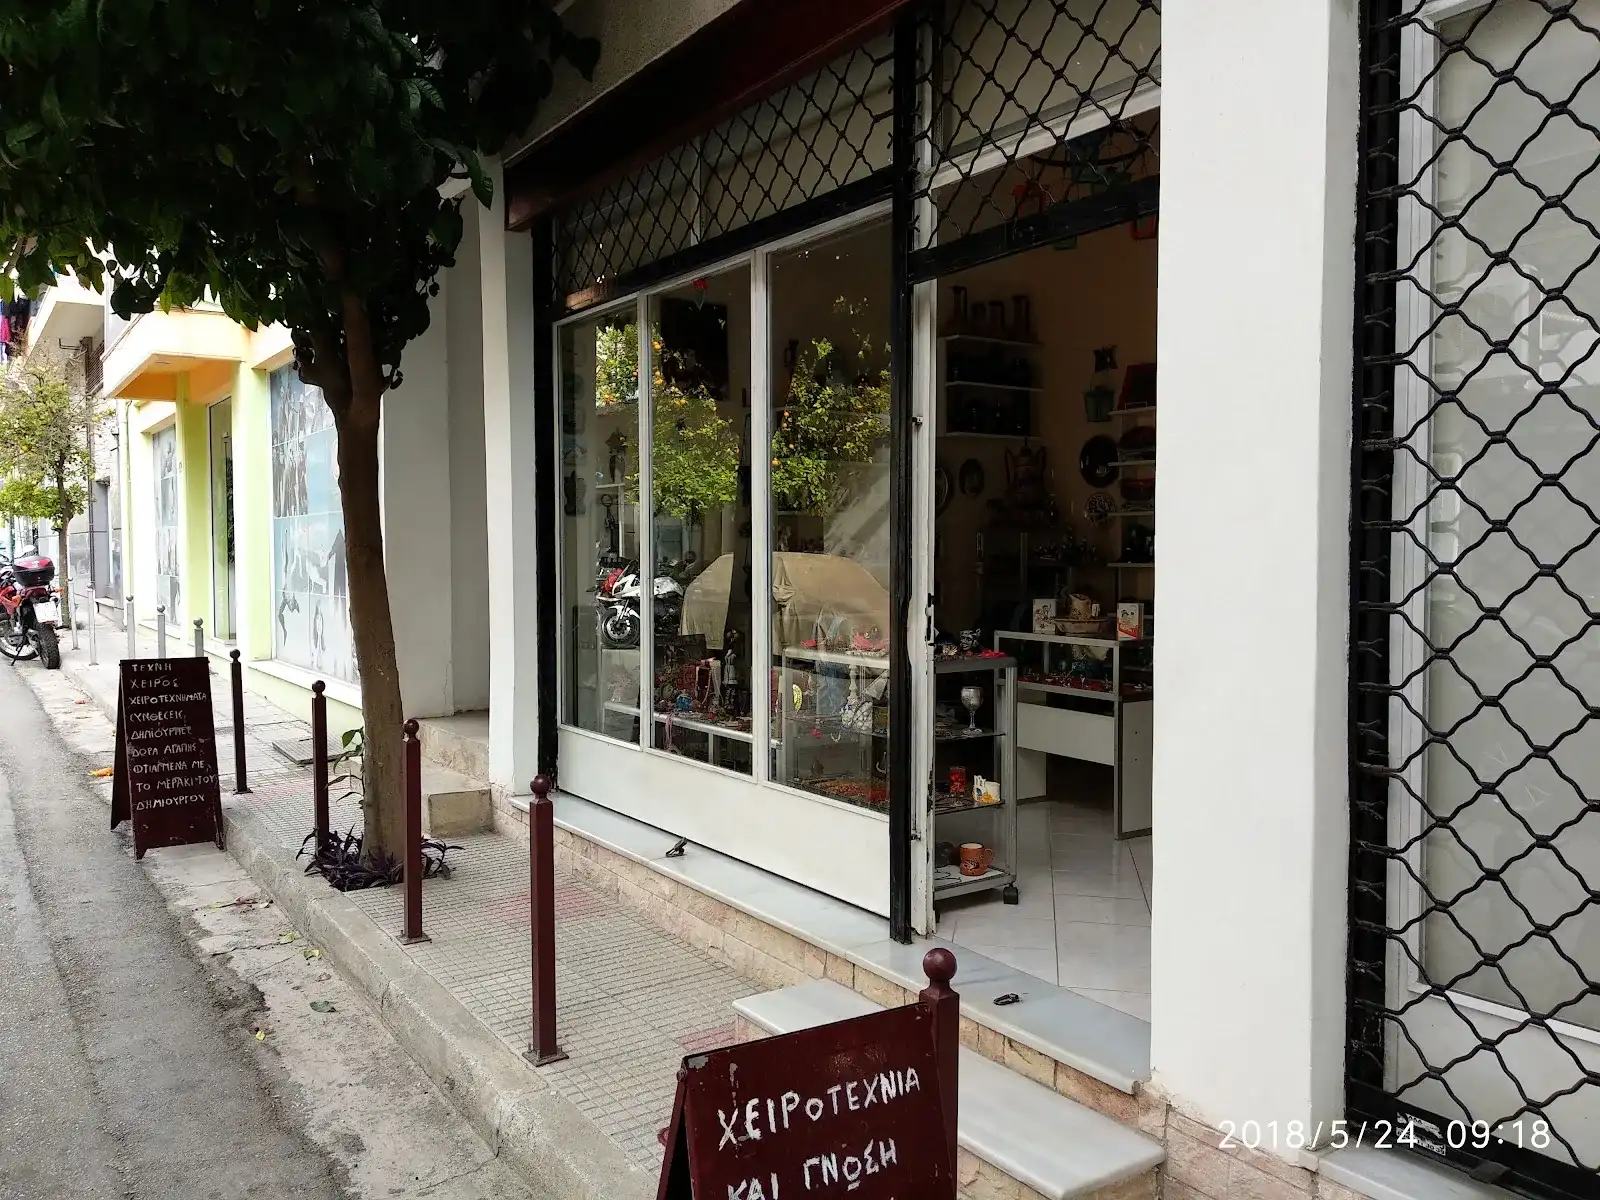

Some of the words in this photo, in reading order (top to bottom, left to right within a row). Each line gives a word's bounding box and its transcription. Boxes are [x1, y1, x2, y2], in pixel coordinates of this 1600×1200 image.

[131, 662, 172, 672] ΤΕΧΝΗ
[129, 692, 207, 705] ΧΕΙΡΟΤΕΧΝΗΜΑΤΑ
[191, 760, 205, 769] ΜΕ
[135, 782, 151, 793] ΤΟ
[156, 776, 194, 790] ΜΕΡΑΚΙ
[136, 794, 205, 811] ΔΗΜΙΟΥΡΓΟΥ
[717, 1066, 921, 1151] ΧΕΙΡΟΤΕΧΝΙΑ
[727, 1172, 780, 1200] ΚΑΙ
